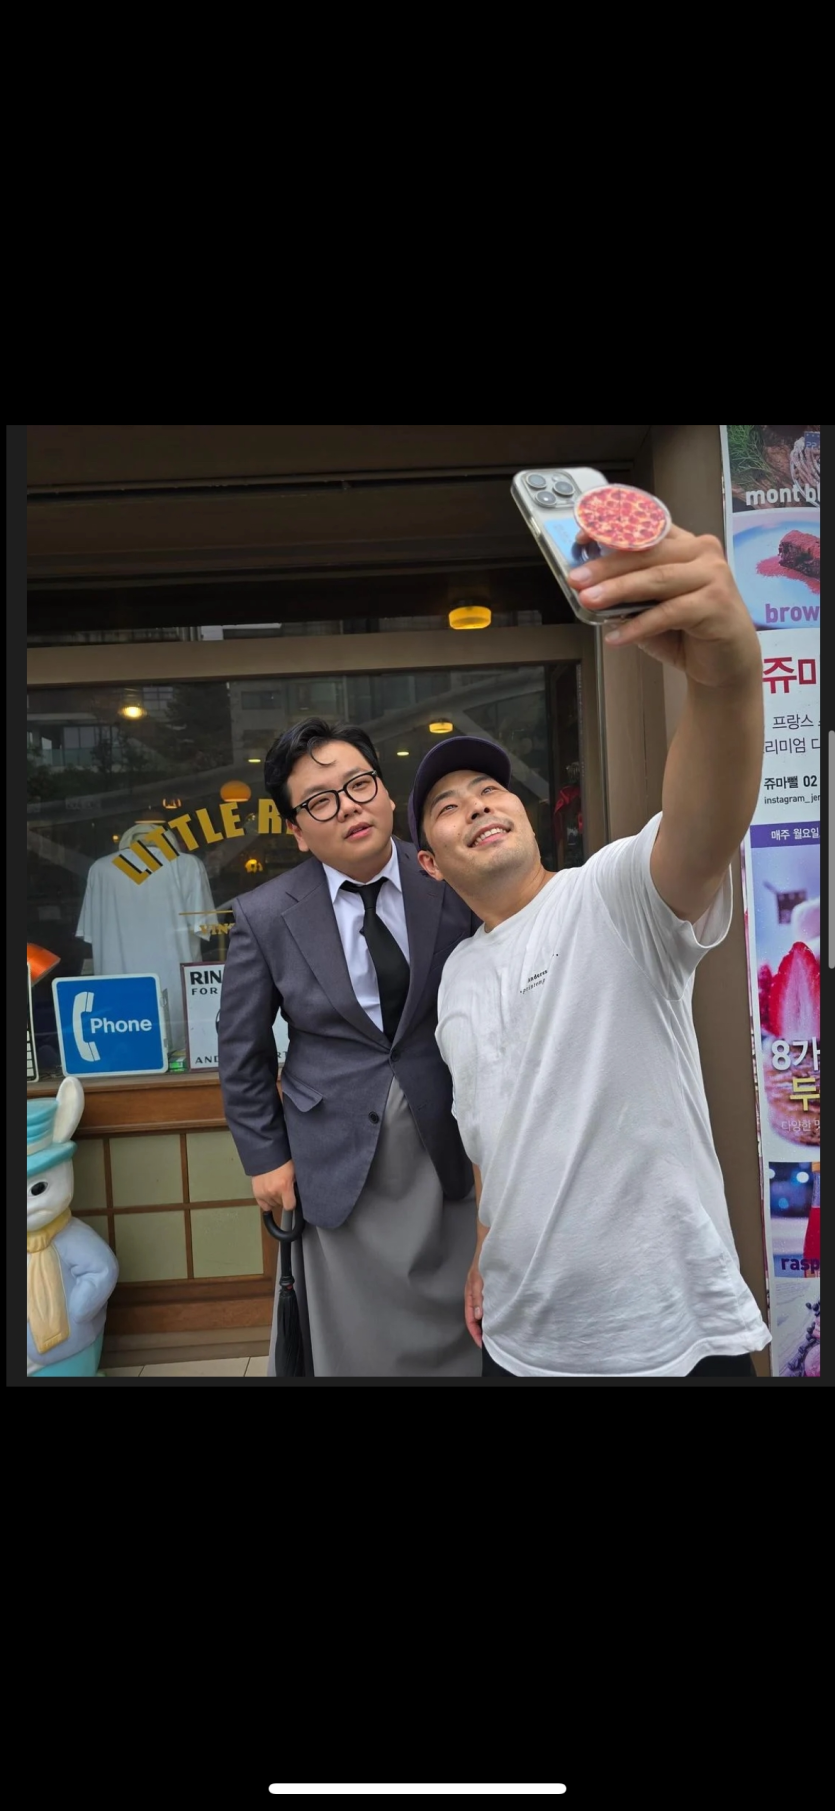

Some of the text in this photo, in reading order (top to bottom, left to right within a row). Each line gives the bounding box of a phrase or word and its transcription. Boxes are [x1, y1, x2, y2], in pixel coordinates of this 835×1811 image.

[745, 484, 799, 506] mont
[772, 714, 814, 730] 프랑스
[763, 737, 806, 755] 리미엄
[803, 775, 818, 788] 02
[112, 798, 294, 886] LITTLE R
[771, 827, 820, 840] 매주 월요일
[191, 987, 218, 996] FOR
[90, 1017, 152, 1034] Phone
[789, 1077, 820, 1112] 두
[781, 1119, 811, 1132] 다양한
[781, 1256, 820, 1275] rasp
